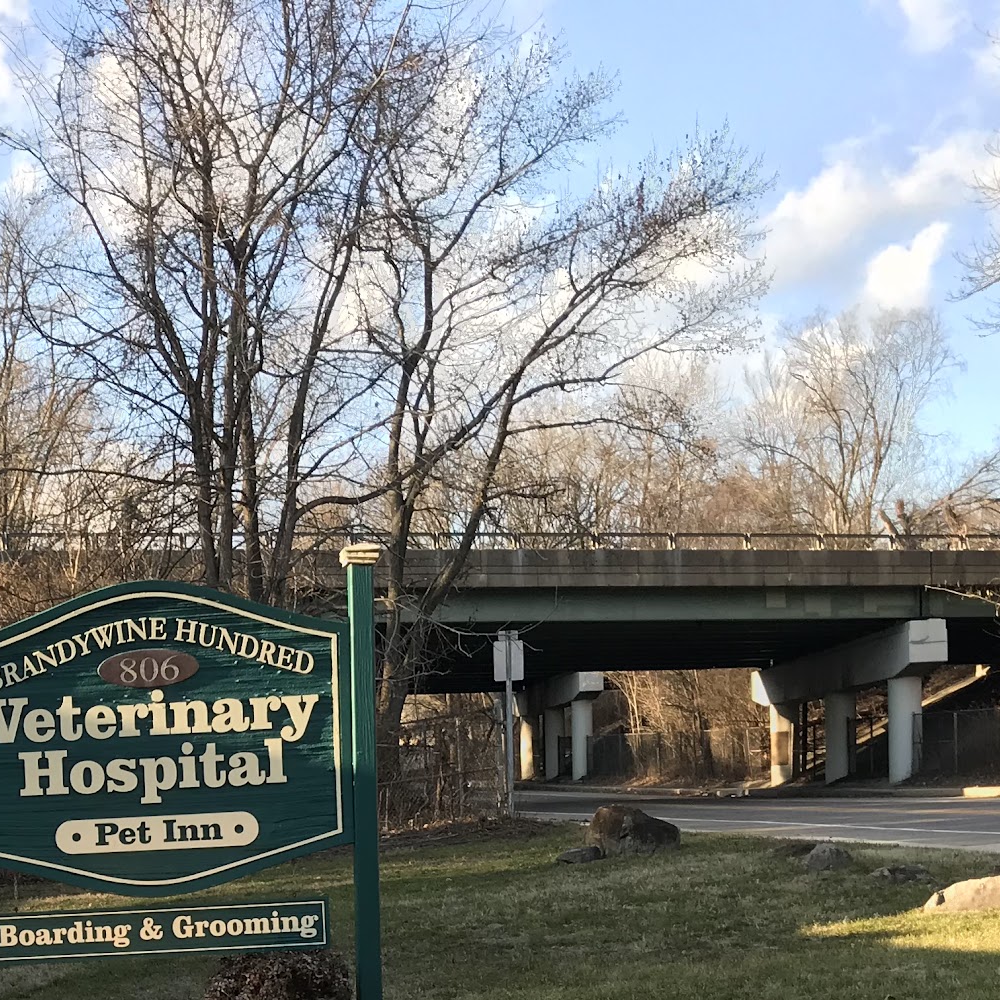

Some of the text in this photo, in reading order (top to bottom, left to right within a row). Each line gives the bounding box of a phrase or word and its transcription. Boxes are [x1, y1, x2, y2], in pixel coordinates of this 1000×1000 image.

[174, 618, 314, 674] HUNDRED
[119, 655, 180, 683] 806
[18, 738, 287, 804] Hospital
[95, 819, 223, 846] Pet Inn
[140, 916, 163, 941] &
[172, 910, 319, 939] Grooming
